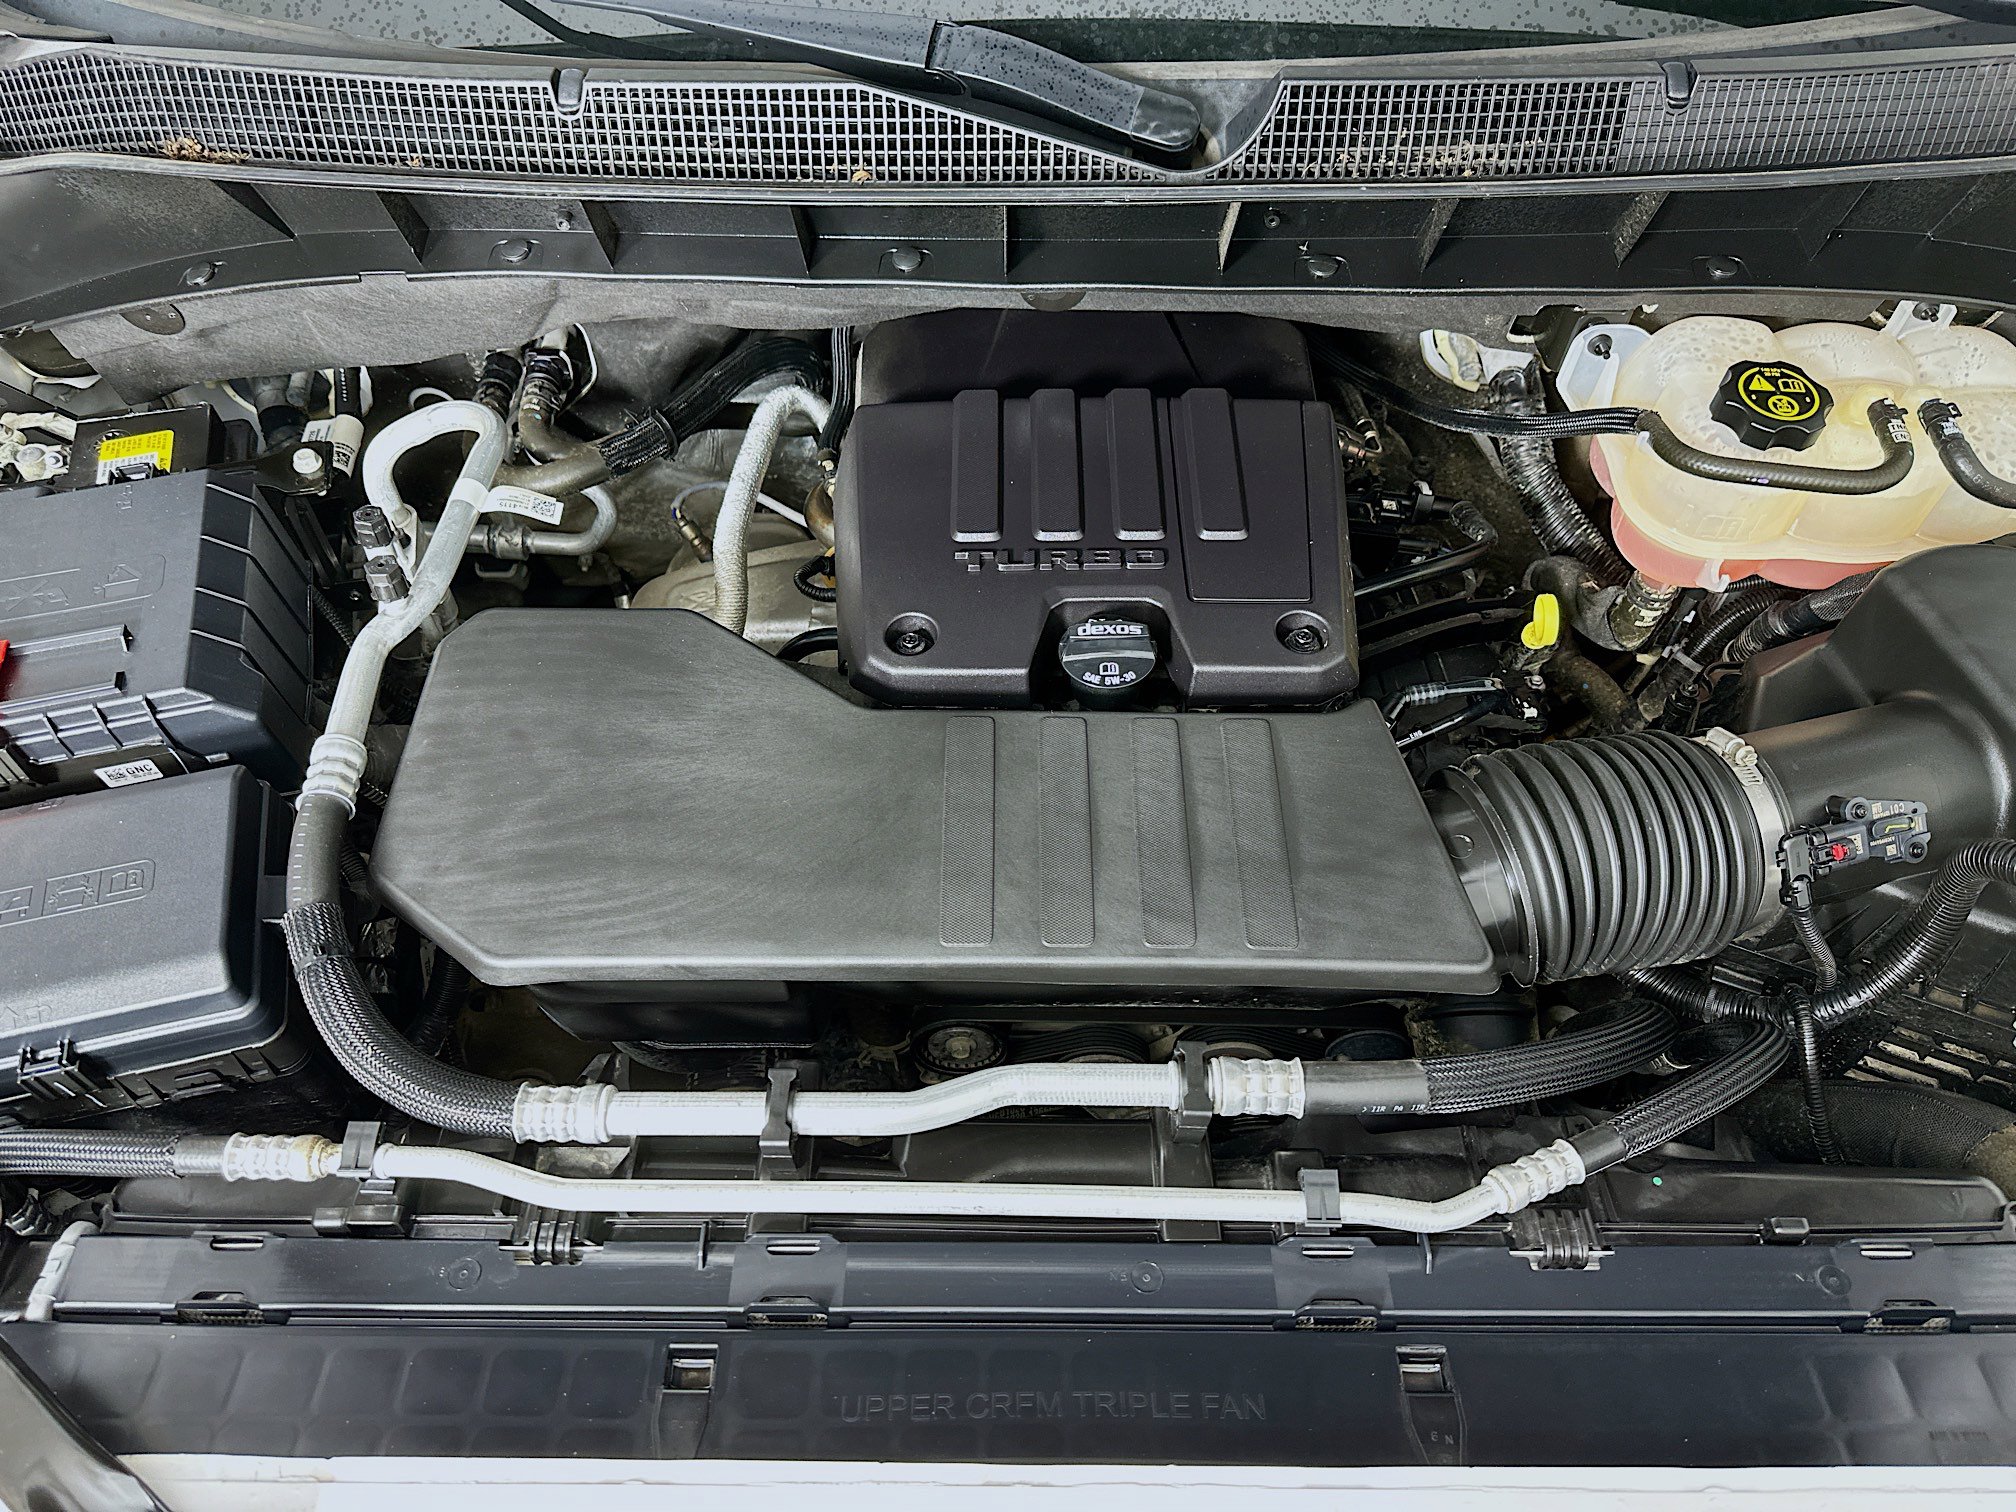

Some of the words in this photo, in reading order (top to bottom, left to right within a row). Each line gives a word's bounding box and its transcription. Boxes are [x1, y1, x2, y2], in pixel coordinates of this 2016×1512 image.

[954, 548, 1167, 572] TURBO
[1077, 622, 1144, 636] dexos
[1082, 671, 1101, 684] SAE
[1104, 672, 1137, 686] 5W-30
[125, 764, 153, 775] GNC
[840, 1394, 956, 1423] UPPER
[965, 1391, 1063, 1420] CRFM
[1072, 1392, 1192, 1419] TRIPLE
[1200, 1393, 1267, 1421] FAN
